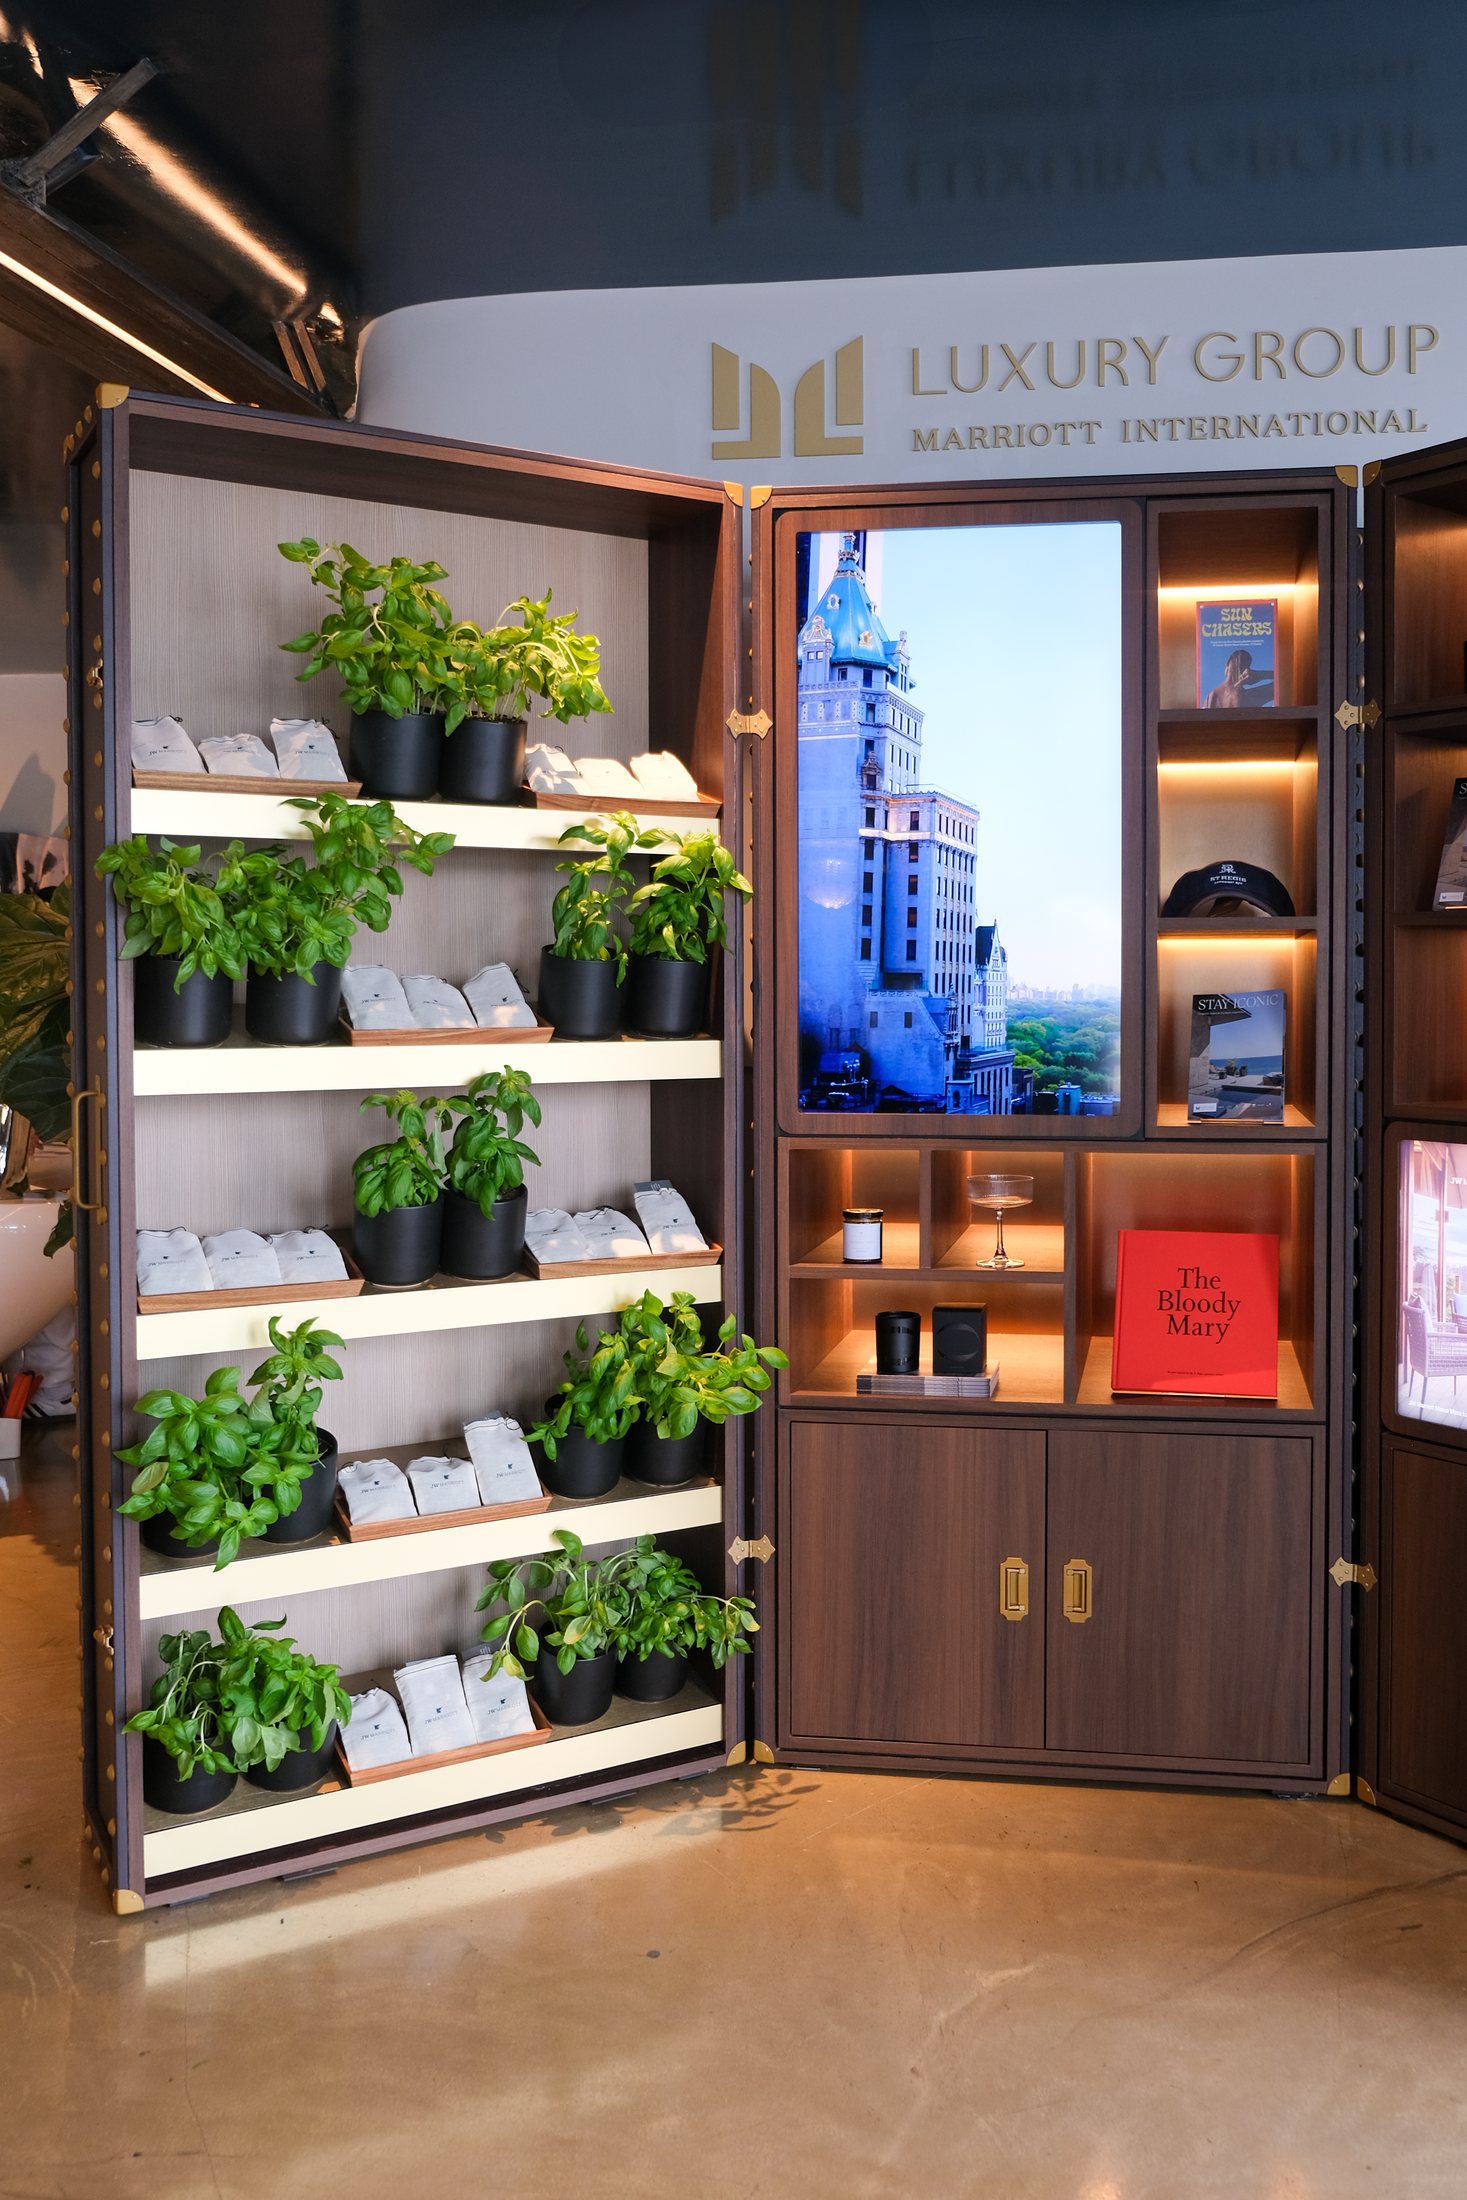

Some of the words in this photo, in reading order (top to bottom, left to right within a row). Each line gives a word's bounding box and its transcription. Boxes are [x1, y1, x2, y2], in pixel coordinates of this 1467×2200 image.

[911, 334, 1170, 396] LUXURY
[1194, 322, 1440, 382] GROUP
[911, 420, 1103, 453] MARRIOTT
[1122, 407, 1429, 445] INTERNATIONAL
[1220, 607, 1252, 622] SUN
[1201, 621, 1272, 638] CHASERS
[1198, 998, 1229, 1011] STAY
[1233, 993, 1278, 1009] ICONIC
[1450, 1176, 1463, 1185] JW
[1177, 1266, 1221, 1290] The
[1156, 1289, 1241, 1321] Bloody
[1166, 1314, 1230, 1344] Mary
